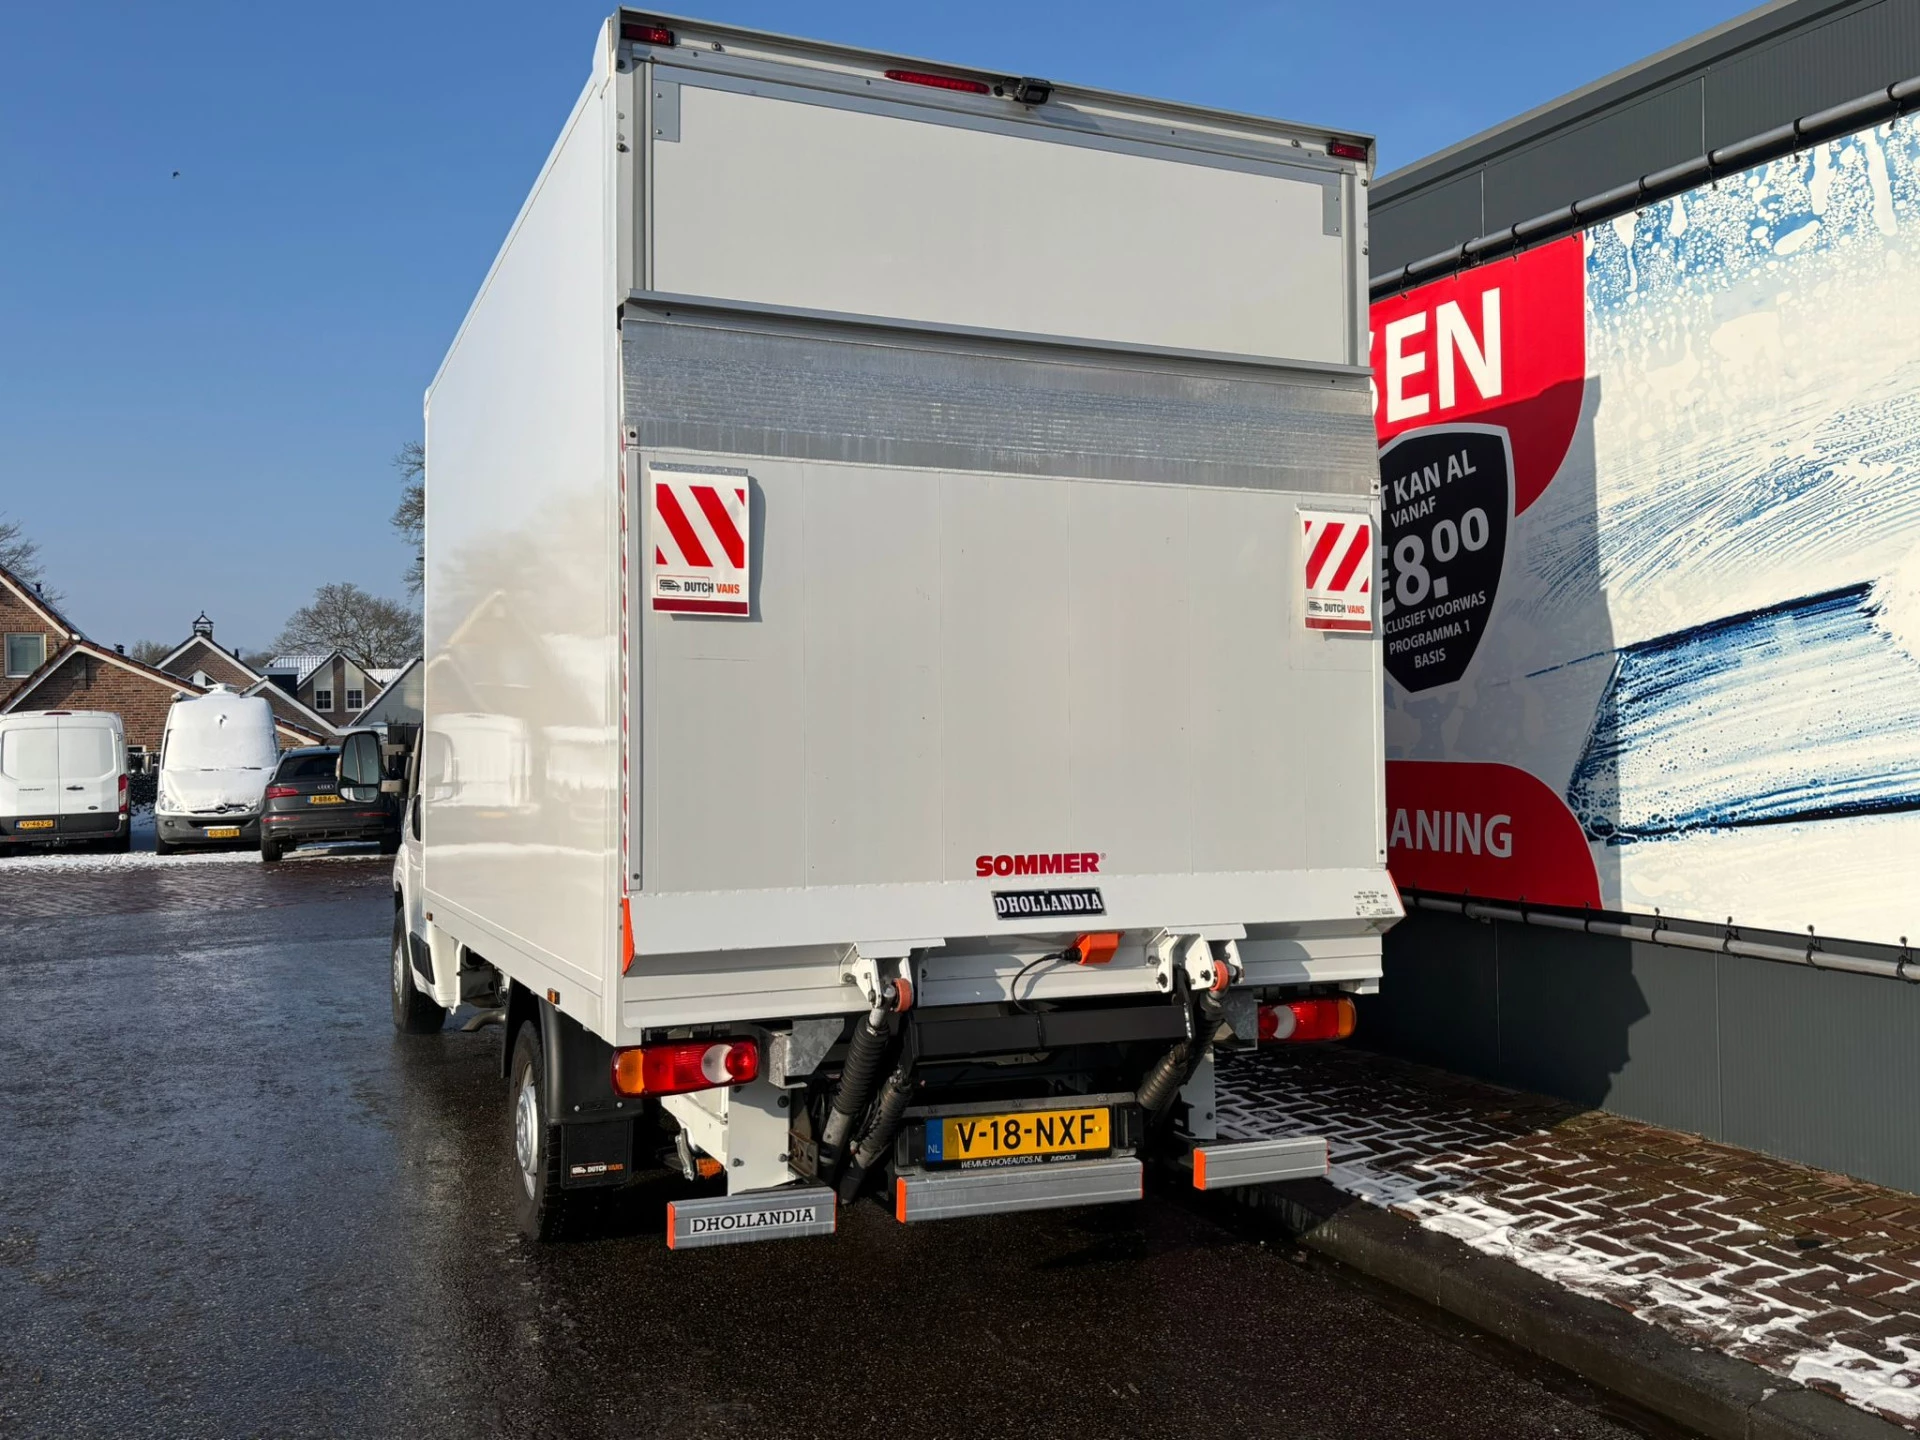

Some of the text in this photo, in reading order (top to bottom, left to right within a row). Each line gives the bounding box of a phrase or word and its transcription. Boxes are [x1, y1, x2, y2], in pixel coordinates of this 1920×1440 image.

[1370, 287, 1502, 424] EN
[1394, 462, 1441, 505] KAN
[1446, 450, 1477, 484] AL
[1390, 496, 1437, 528] VANAF
[684, 581, 740, 594] DUTCH VANS
[1324, 603, 1365, 614] DUTCH VANS
[1428, 590, 1487, 621] VOORWAS
[1389, 619, 1471, 655] PROGRAMMA 1
[1414, 647, 1447, 668] BASIS
[1387, 808, 1513, 858] ANING
[995, 892, 1104, 914] DHOLLANDIA
[957, 1113, 1096, 1153] V-18-NXF
[928, 1144, 941, 1154] NL
[961, 1154, 1043, 1169] WEMMENHOVEAUTOS.NL
[587, 1163, 624, 1173] DUTCH VANS
[692, 1208, 814, 1233] DHOLLANDIA
